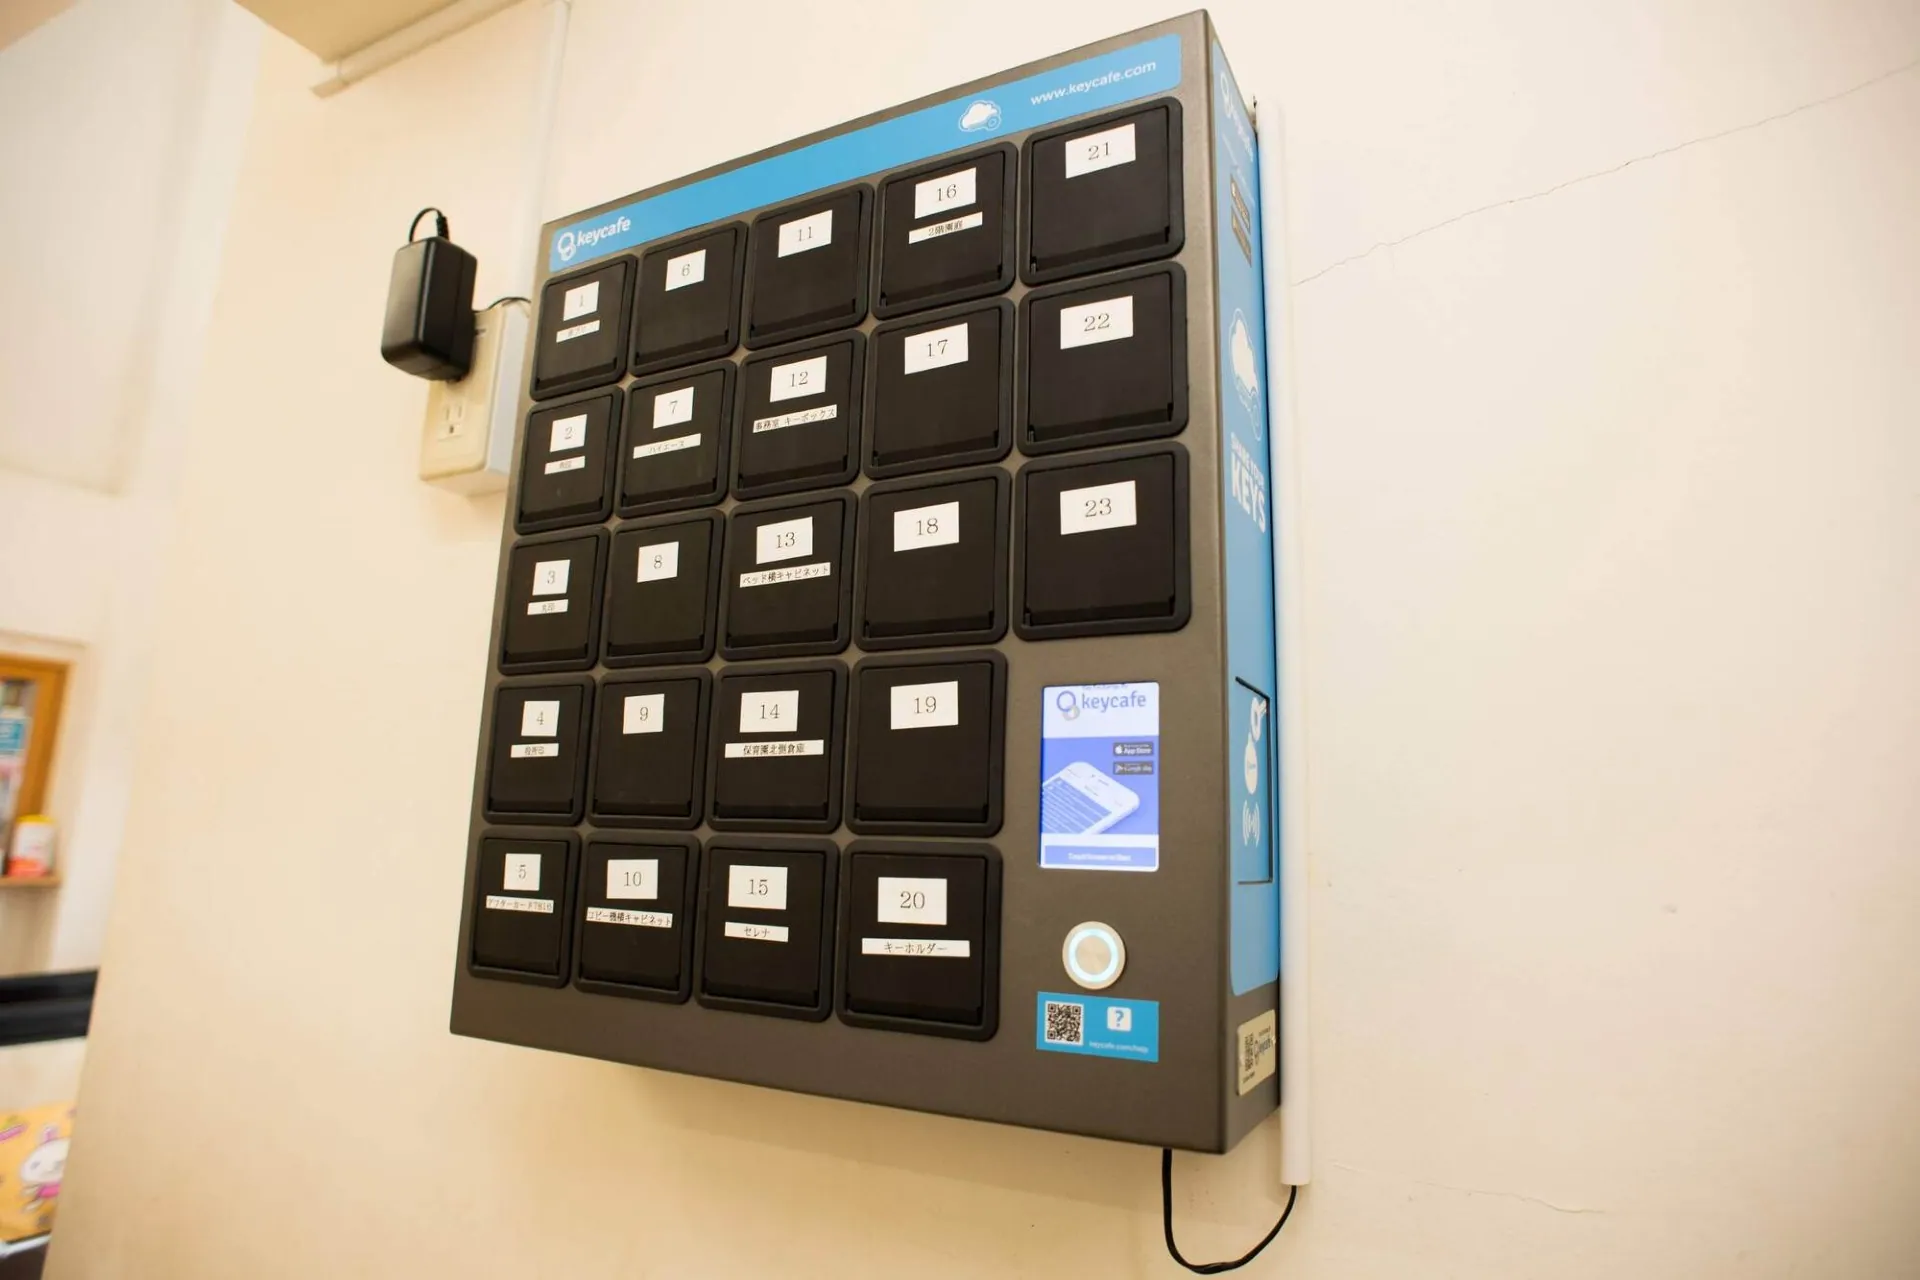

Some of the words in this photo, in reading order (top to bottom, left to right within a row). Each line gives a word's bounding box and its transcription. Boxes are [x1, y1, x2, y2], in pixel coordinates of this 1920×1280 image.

[1030, 61, 1157, 105] www.keycafe.com
[1087, 141, 1111, 162] 21
[936, 183, 958, 203] 16
[576, 215, 632, 246] keycafe
[797, 225, 813, 243] 11
[680, 262, 691, 278] 6
[1083, 312, 1111, 333] 22
[926, 338, 949, 358] 17
[789, 370, 809, 388] 12
[668, 399, 679, 415] 7
[563, 425, 573, 441] 2
[1231, 451, 1266, 533] KEYS
[1084, 497, 1113, 519] 23
[915, 517, 939, 536] 18
[775, 531, 797, 549] 13
[652, 554, 663, 570] 8
[546, 570, 556, 585] 3
[913, 695, 938, 715] 19
[1081, 690, 1147, 713] keycafe
[638, 705, 649, 722] 9
[759, 702, 781, 721] 14
[517, 863, 528, 881] 5
[622, 870, 643, 888] 10
[746, 877, 770, 898] 15
[898, 890, 927, 910] 20
[883, 942, 948, 955] キーホルダー
